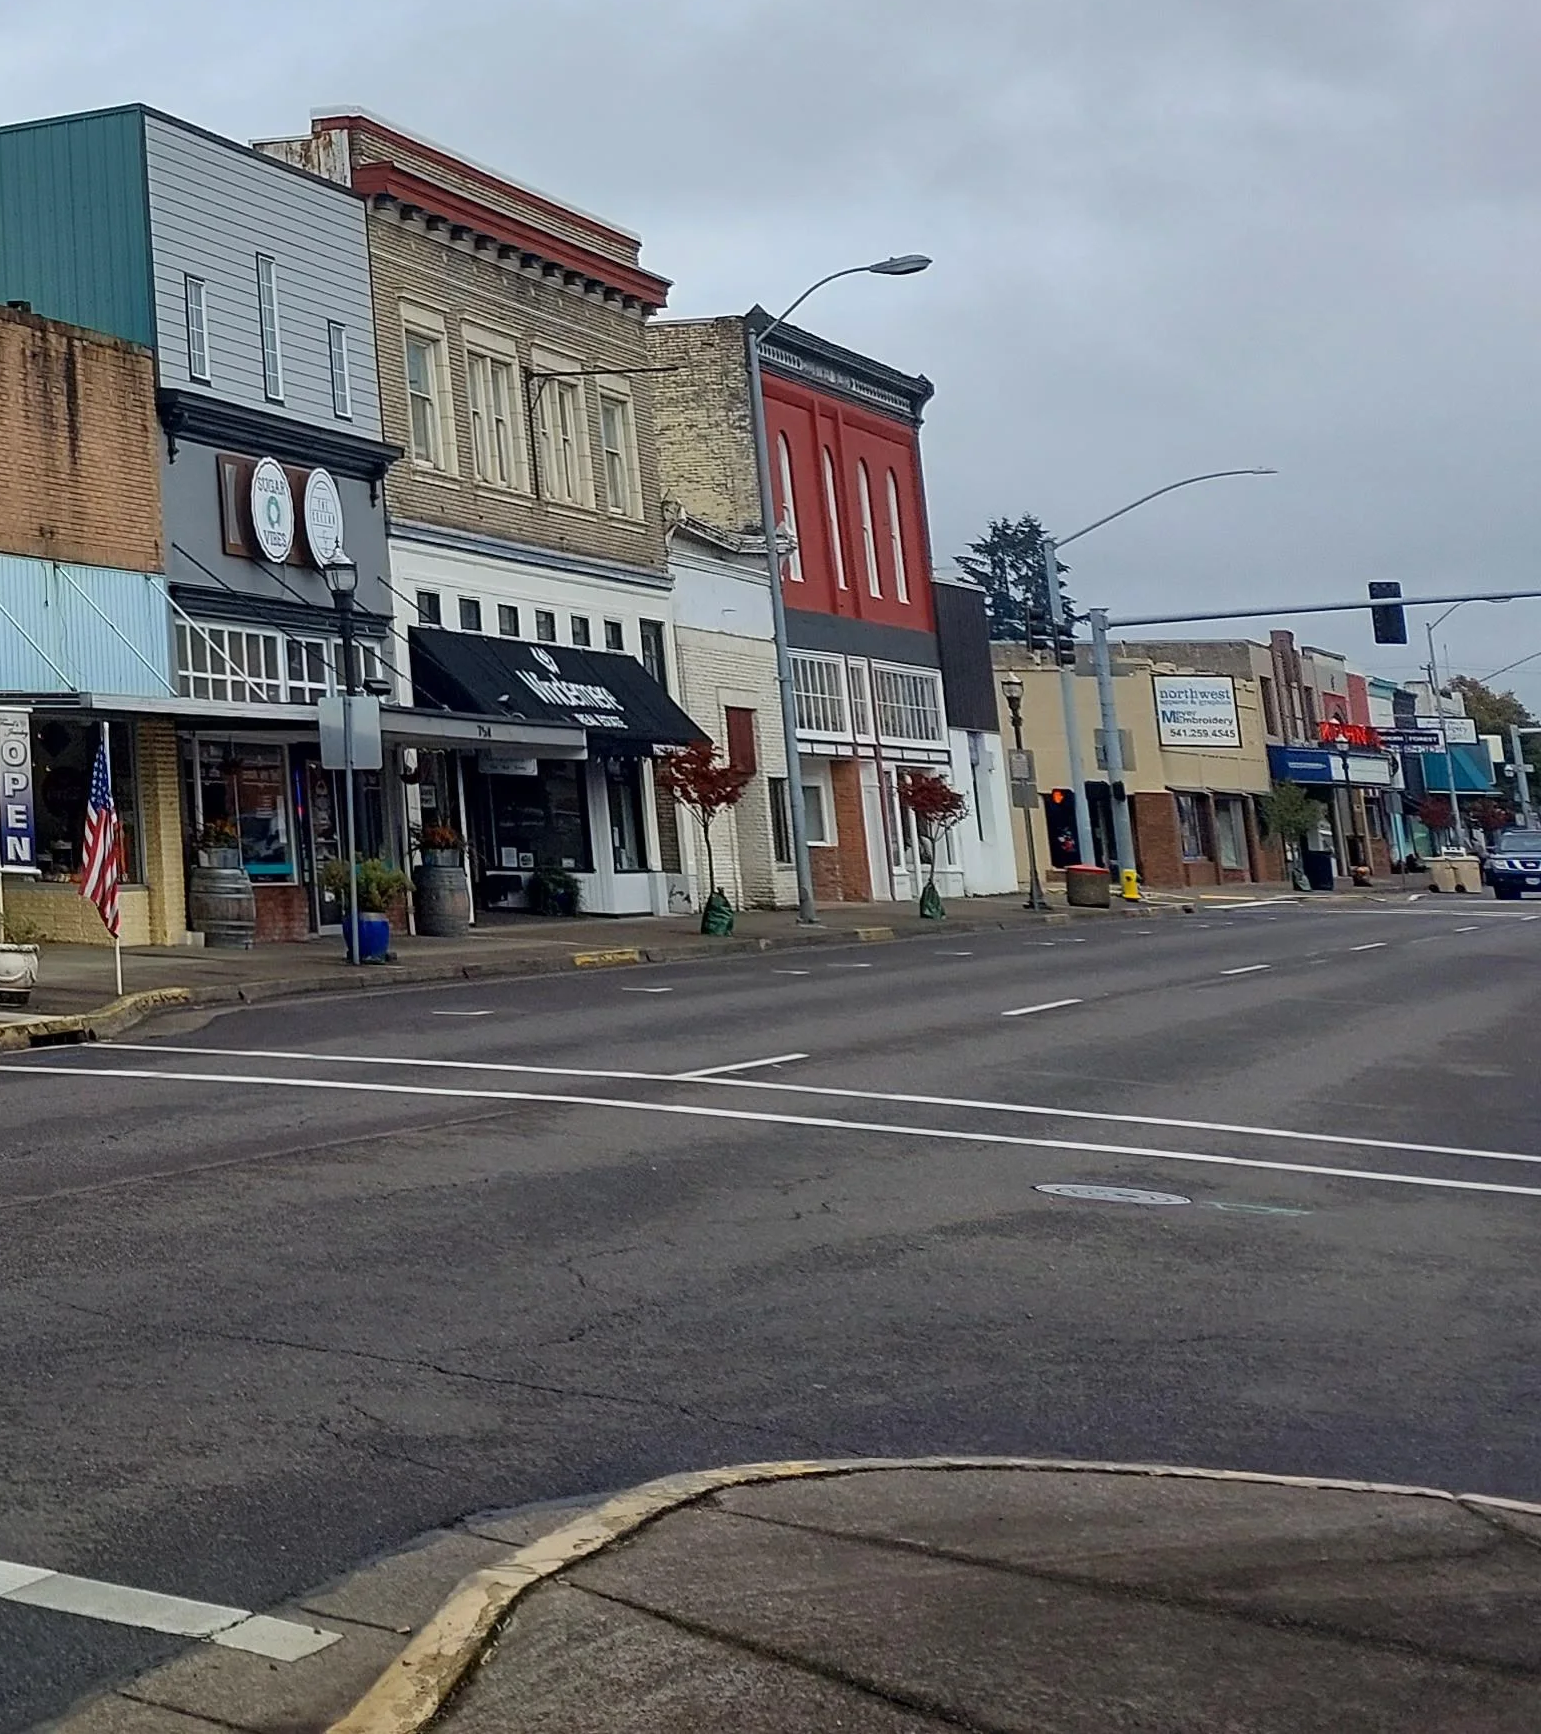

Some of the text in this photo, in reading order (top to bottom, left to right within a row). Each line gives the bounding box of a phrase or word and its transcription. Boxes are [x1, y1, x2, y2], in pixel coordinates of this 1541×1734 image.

[257, 476, 286, 495] SUGAR
[263, 529, 287, 547] VIBES
[1159, 688, 1232, 700] northwest
[1, 739, 32, 863] OPEN
